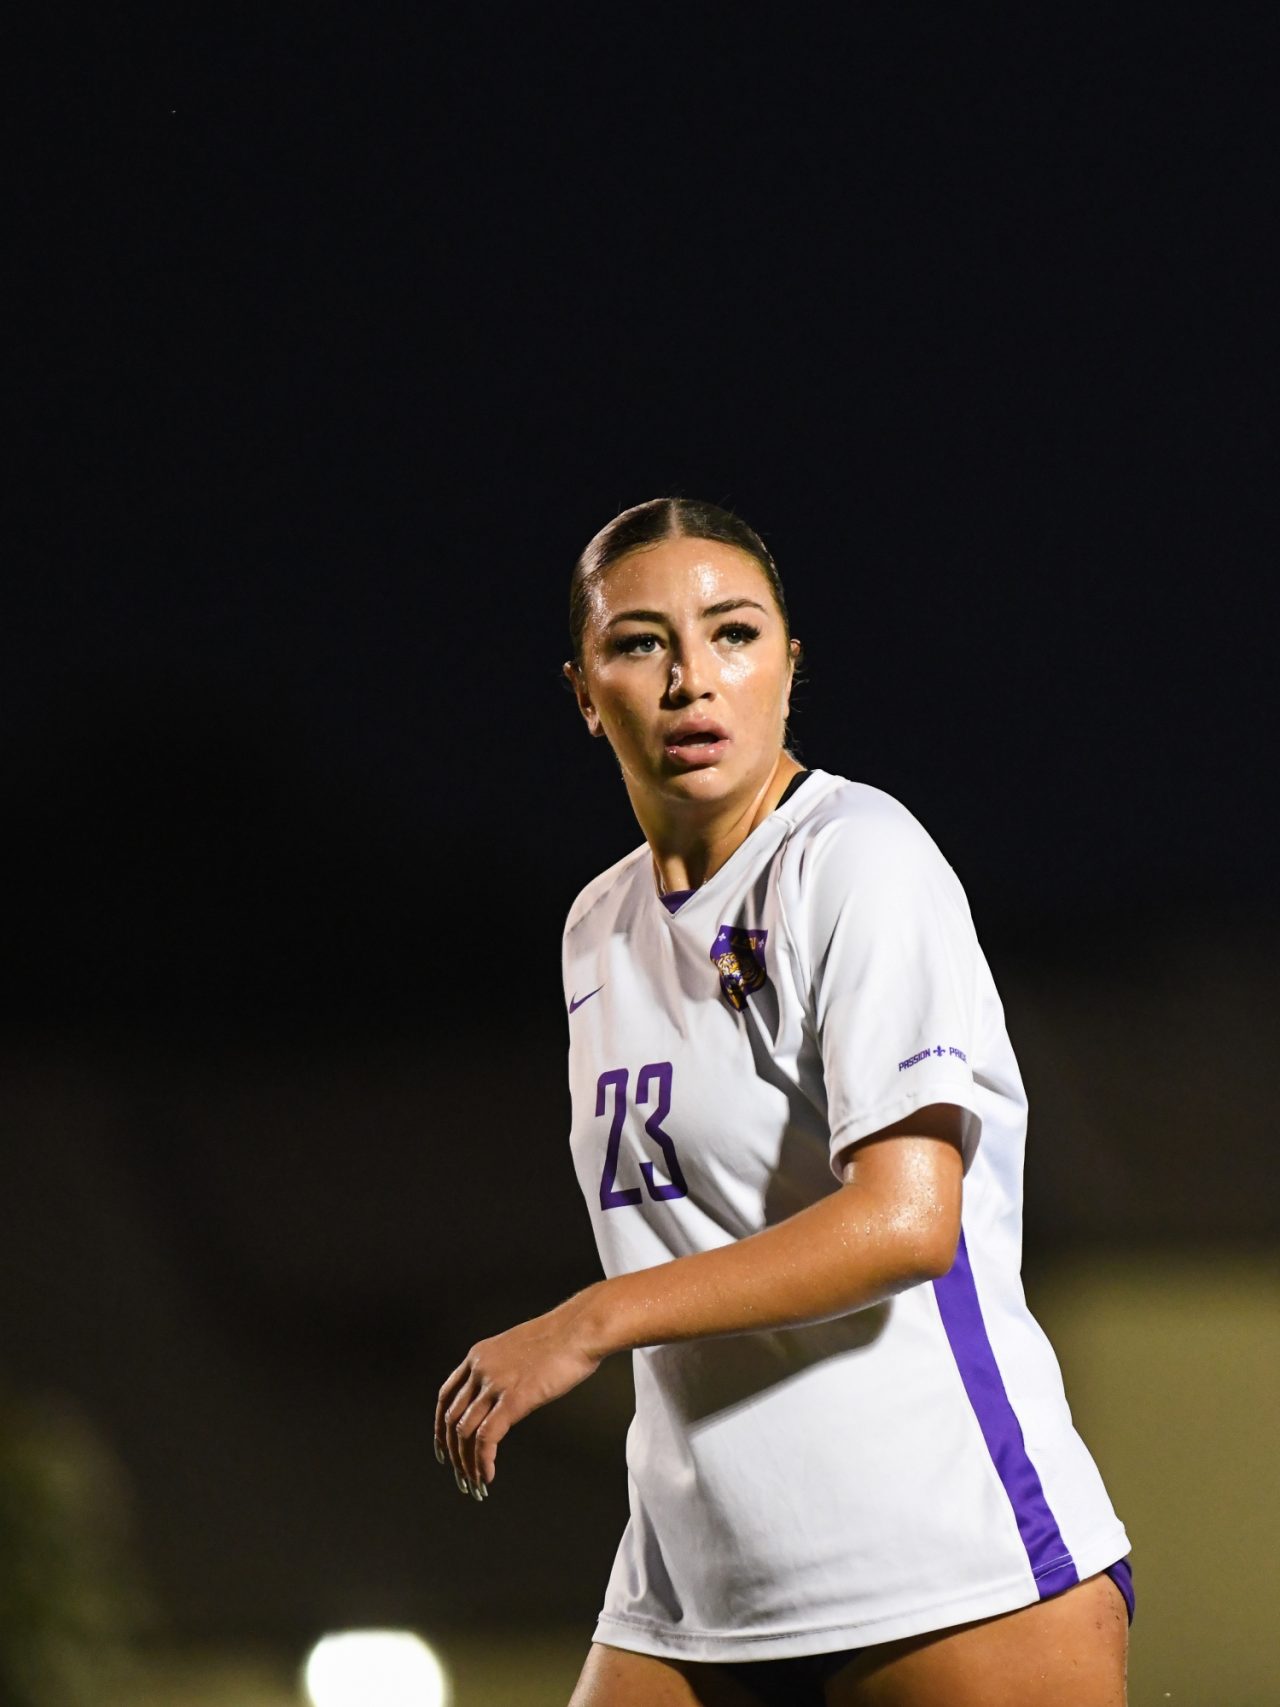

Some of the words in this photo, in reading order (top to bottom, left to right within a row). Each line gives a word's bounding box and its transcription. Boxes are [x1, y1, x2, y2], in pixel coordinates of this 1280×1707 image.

[898, 1048, 931, 1072] PASSION
[948, 1046, 968, 1064] PRID
[595, 1061, 688, 1211] 23
